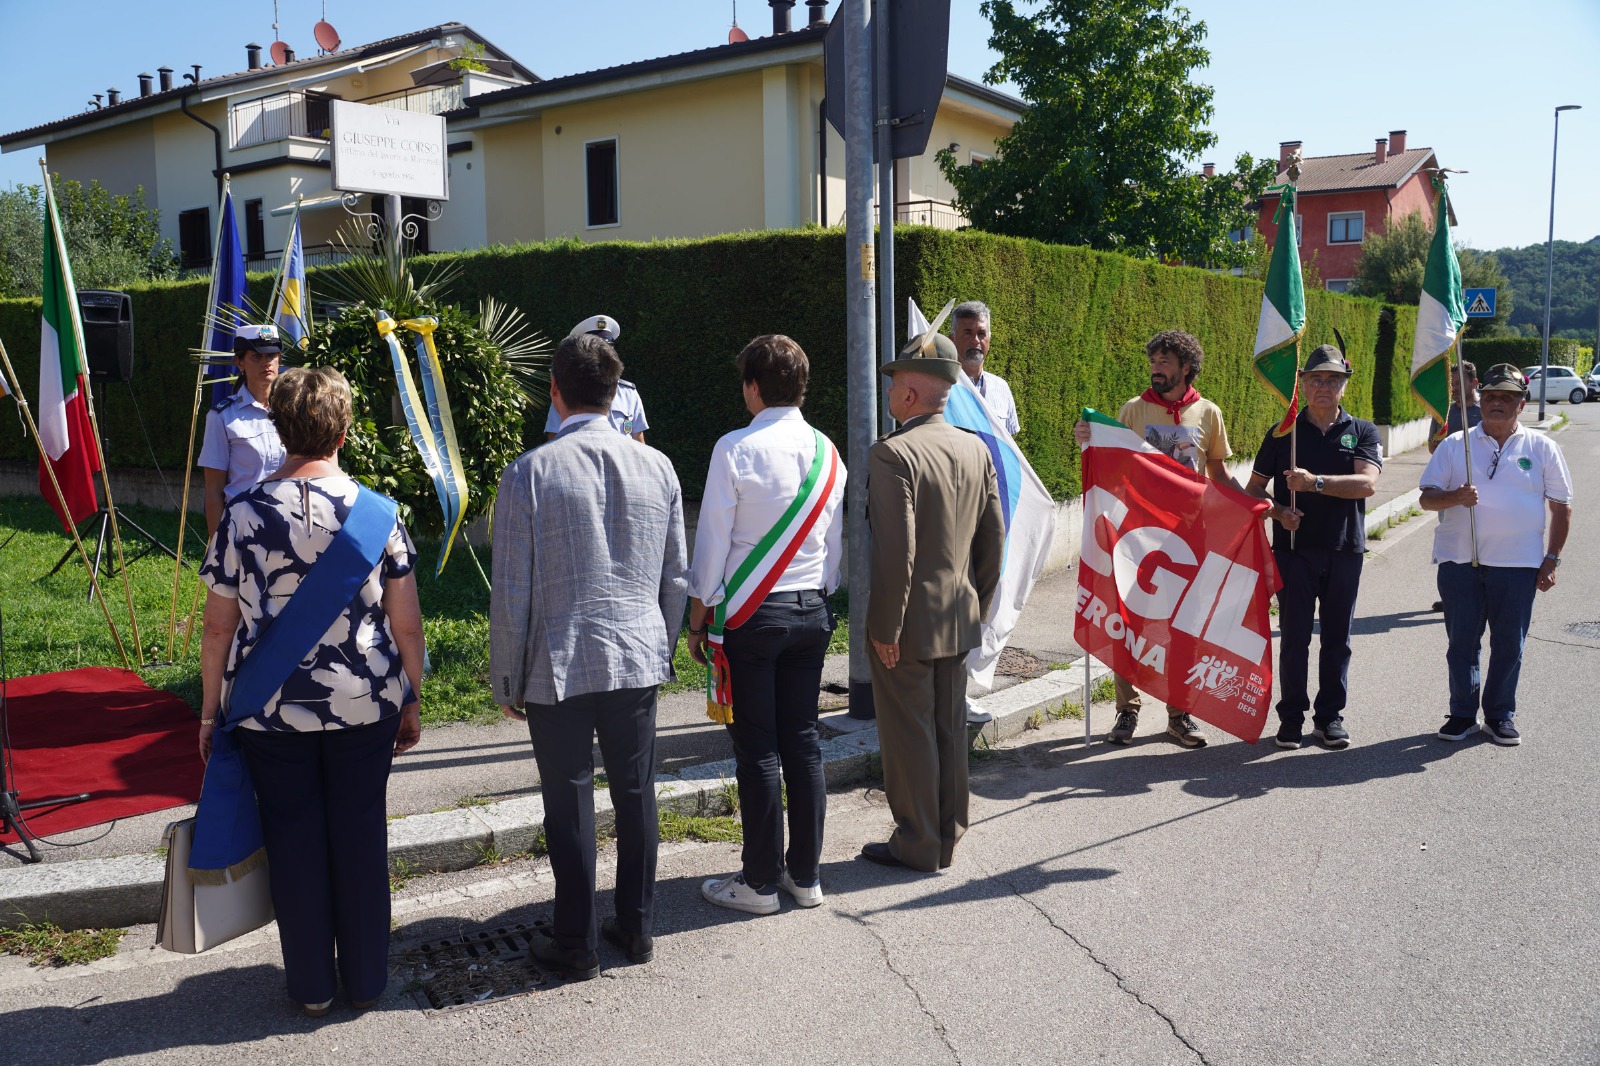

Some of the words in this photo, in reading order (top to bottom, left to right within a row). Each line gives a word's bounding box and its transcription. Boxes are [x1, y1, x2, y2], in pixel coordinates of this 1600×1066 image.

[384, 113, 400, 126] Via
[343, 131, 397, 149] GIUSEPPE
[400, 139, 439, 155] CORSO
[1081, 485, 1267, 666] CGIL
[1075, 584, 1166, 675] ERONA
[1249, 672, 1263, 685] CES
[1245, 682, 1264, 697] ETUC
[1241, 692, 1257, 705] EGB
[1237, 701, 1257, 717] DEFS
